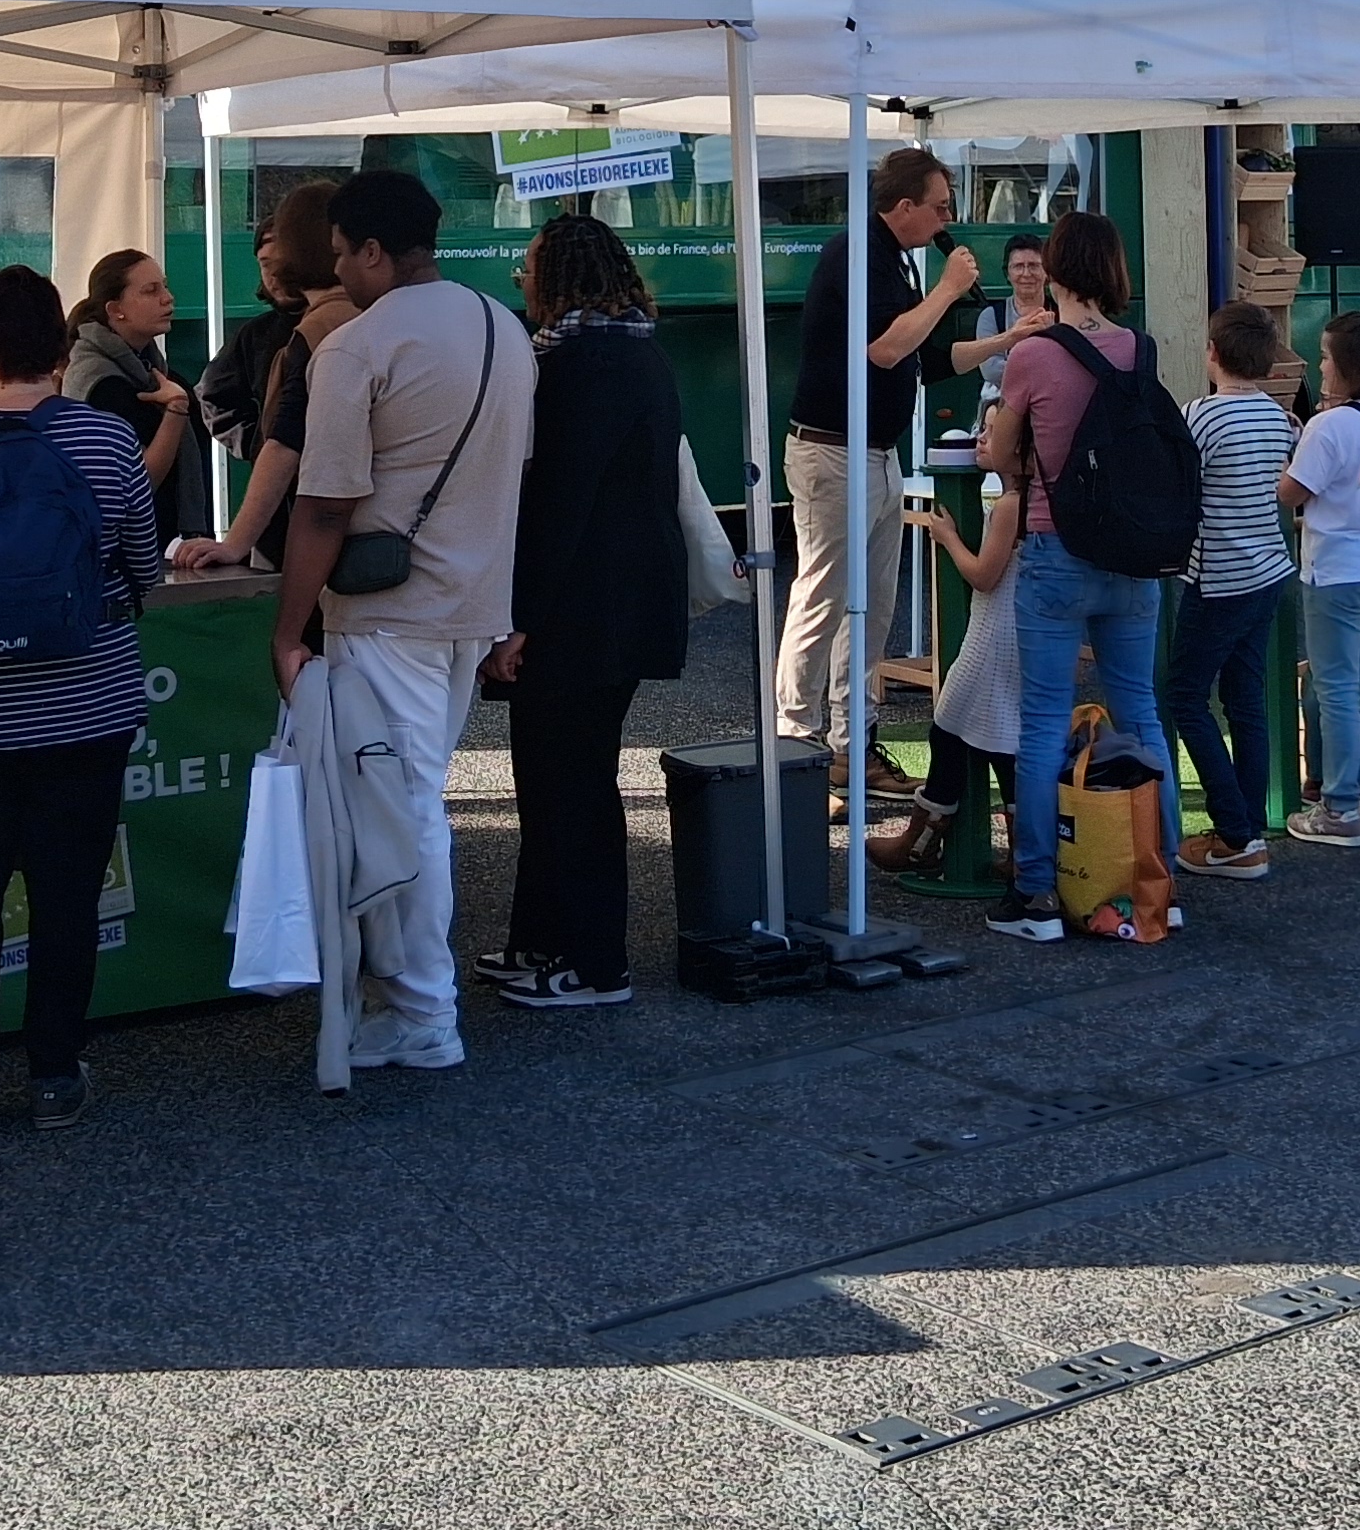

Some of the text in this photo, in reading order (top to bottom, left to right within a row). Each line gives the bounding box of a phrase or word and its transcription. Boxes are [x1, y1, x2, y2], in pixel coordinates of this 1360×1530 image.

[517, 157, 670, 195] #AYONSLEBIOREFLEXE
[500, 245, 510, 258] la
[638, 243, 654, 256] bio
[657, 243, 671, 256] de
[673, 242, 710, 257] France,
[712, 242, 725, 255] de
[764, 241, 823, 257] Européenne
